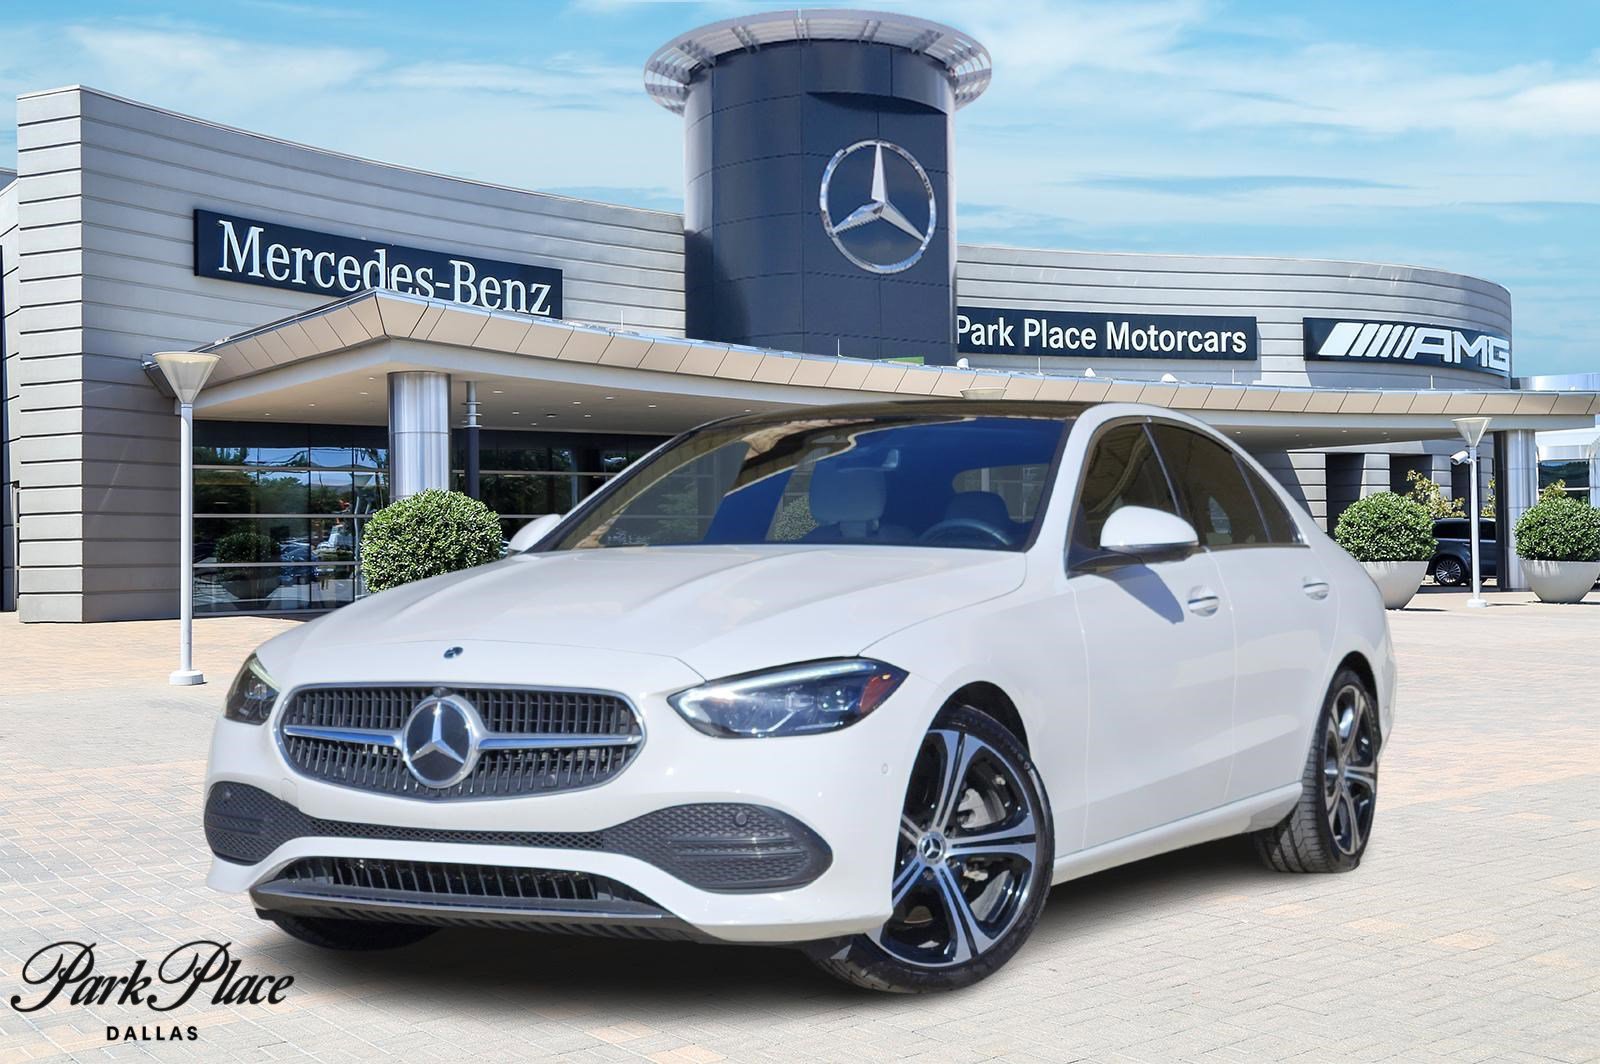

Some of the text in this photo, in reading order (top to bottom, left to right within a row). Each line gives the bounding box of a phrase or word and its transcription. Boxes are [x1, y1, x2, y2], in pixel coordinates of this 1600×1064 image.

[218, 219, 552, 317] Mercedes-Benz
[957, 314, 1248, 353] Park Place Motorcars
